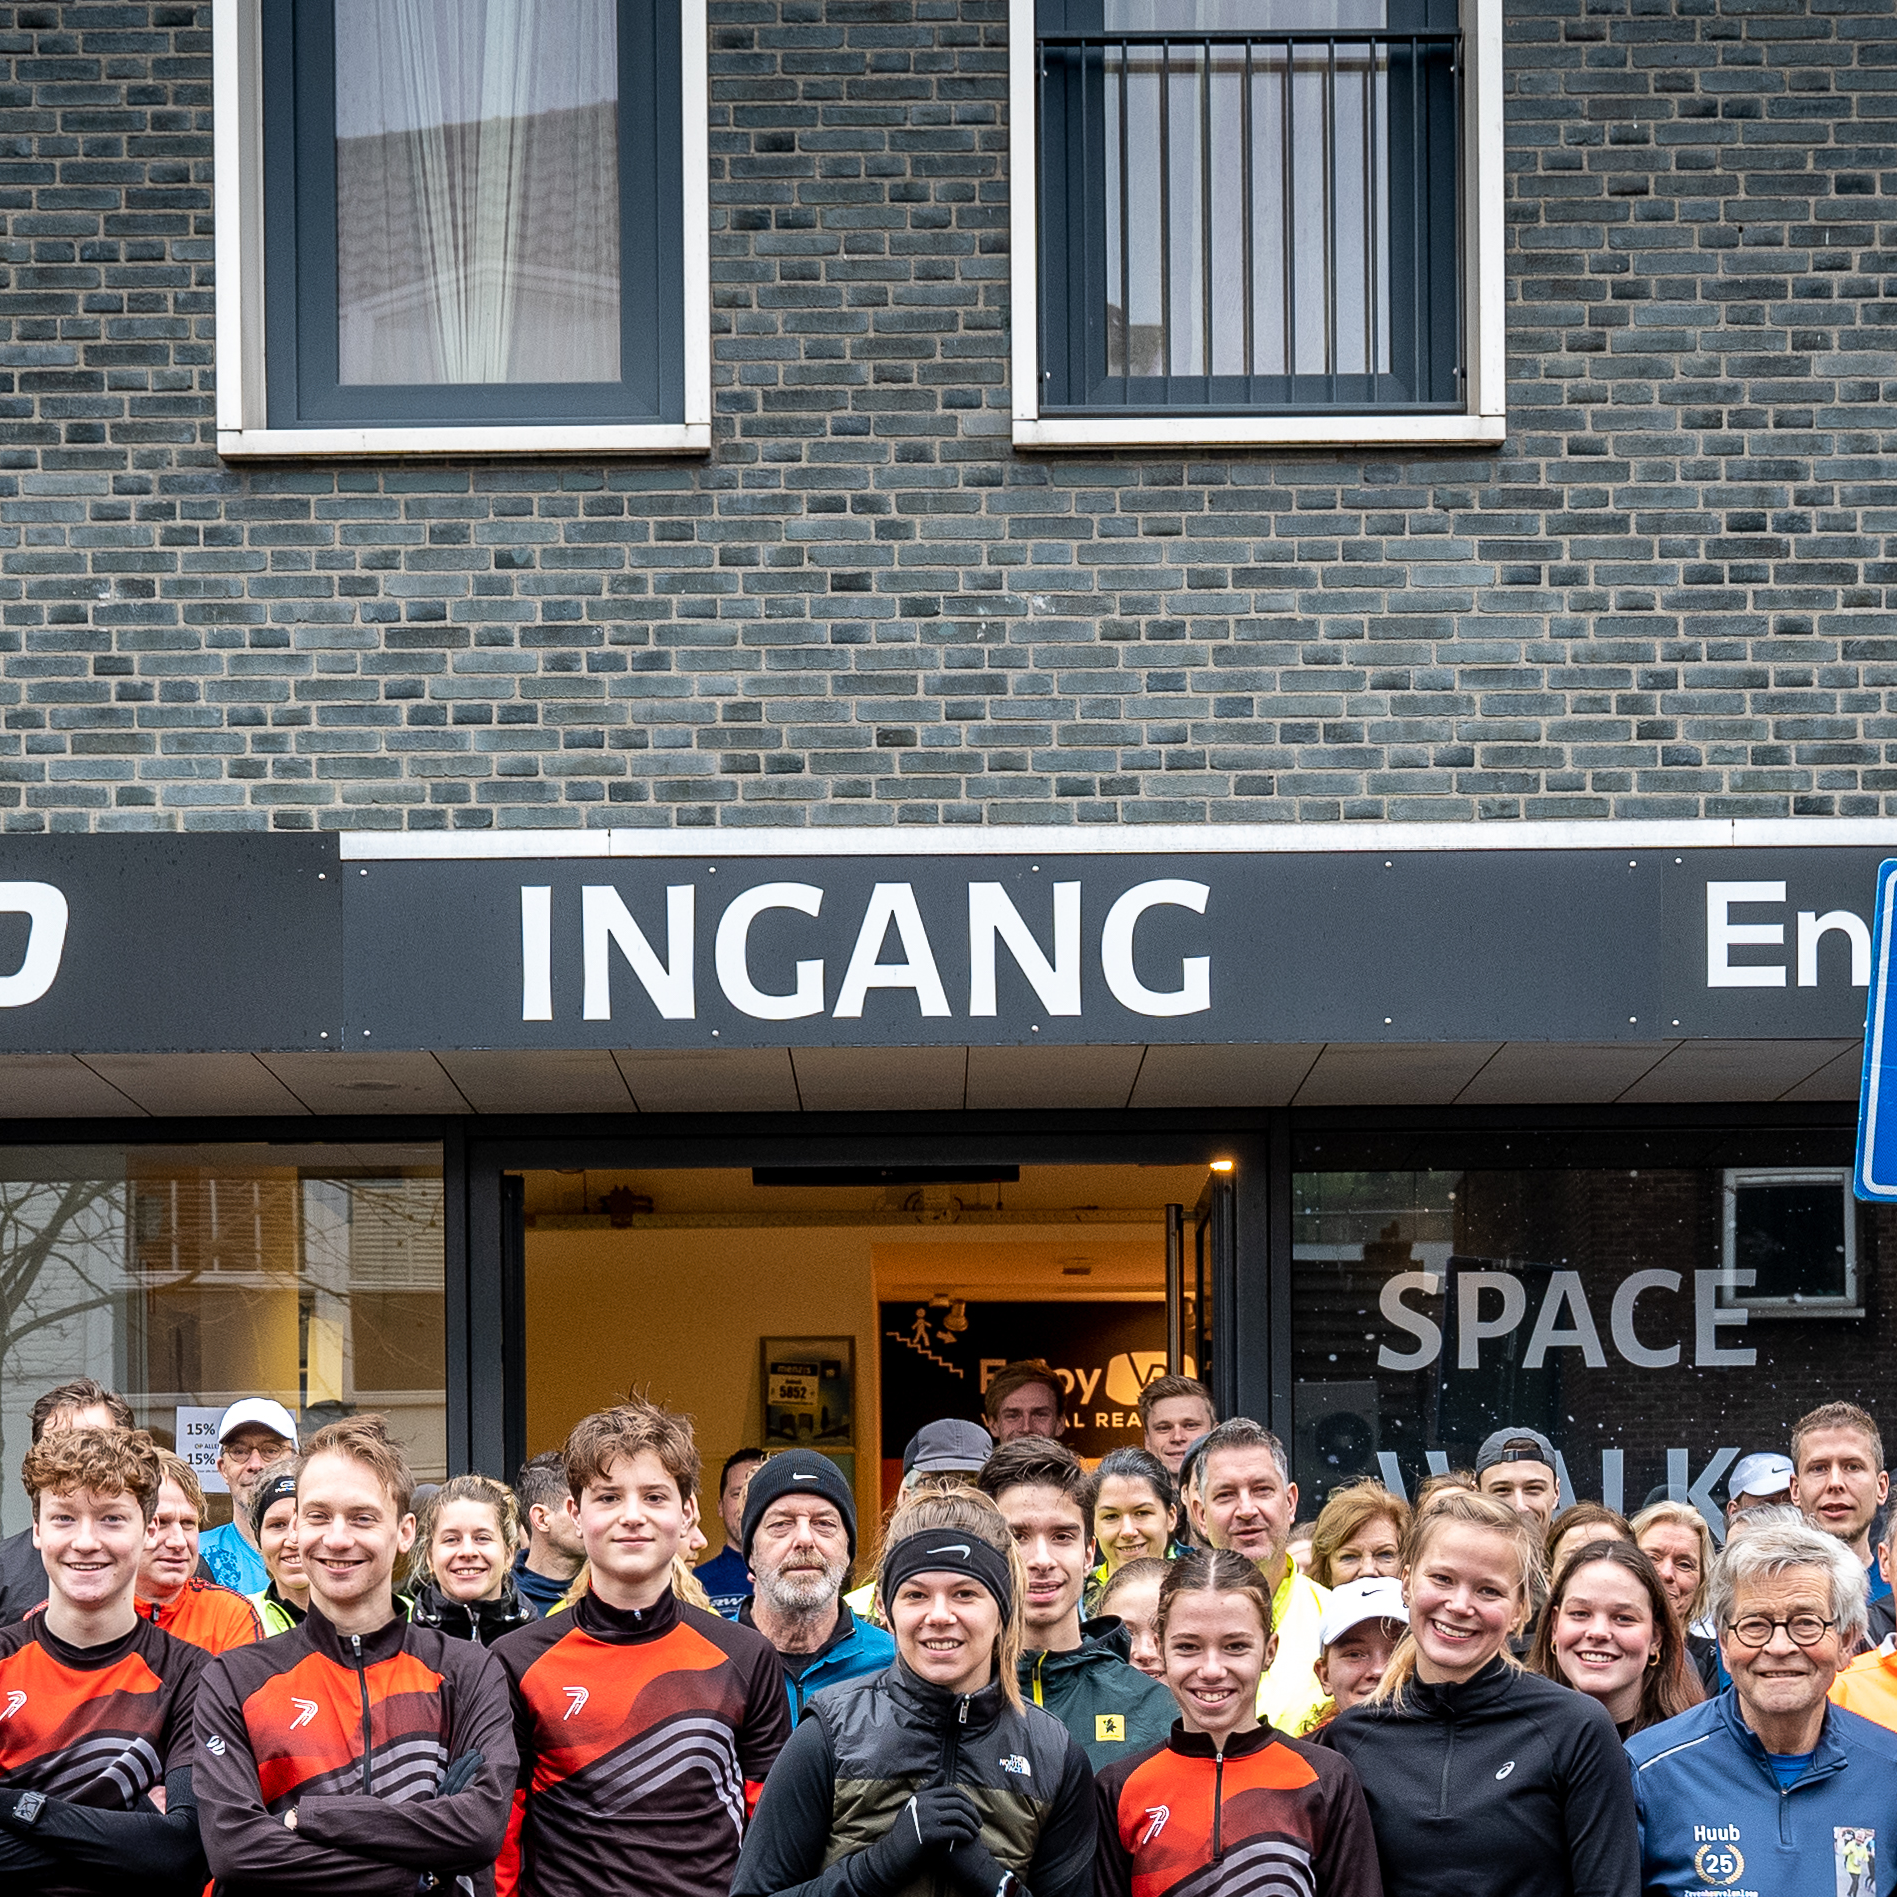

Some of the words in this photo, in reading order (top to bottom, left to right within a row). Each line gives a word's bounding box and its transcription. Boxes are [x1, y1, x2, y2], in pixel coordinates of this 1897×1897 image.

[519, 878, 1212, 1022] INGANG
[1376, 1266, 1759, 1372] SPACE
[779, 1385, 808, 1399] 5852
[186, 1423, 215, 1436] 15%
[187, 1453, 215, 1466] 15%
[1693, 1823, 1741, 1842] Huub
[1705, 1854, 1733, 1874] 25
